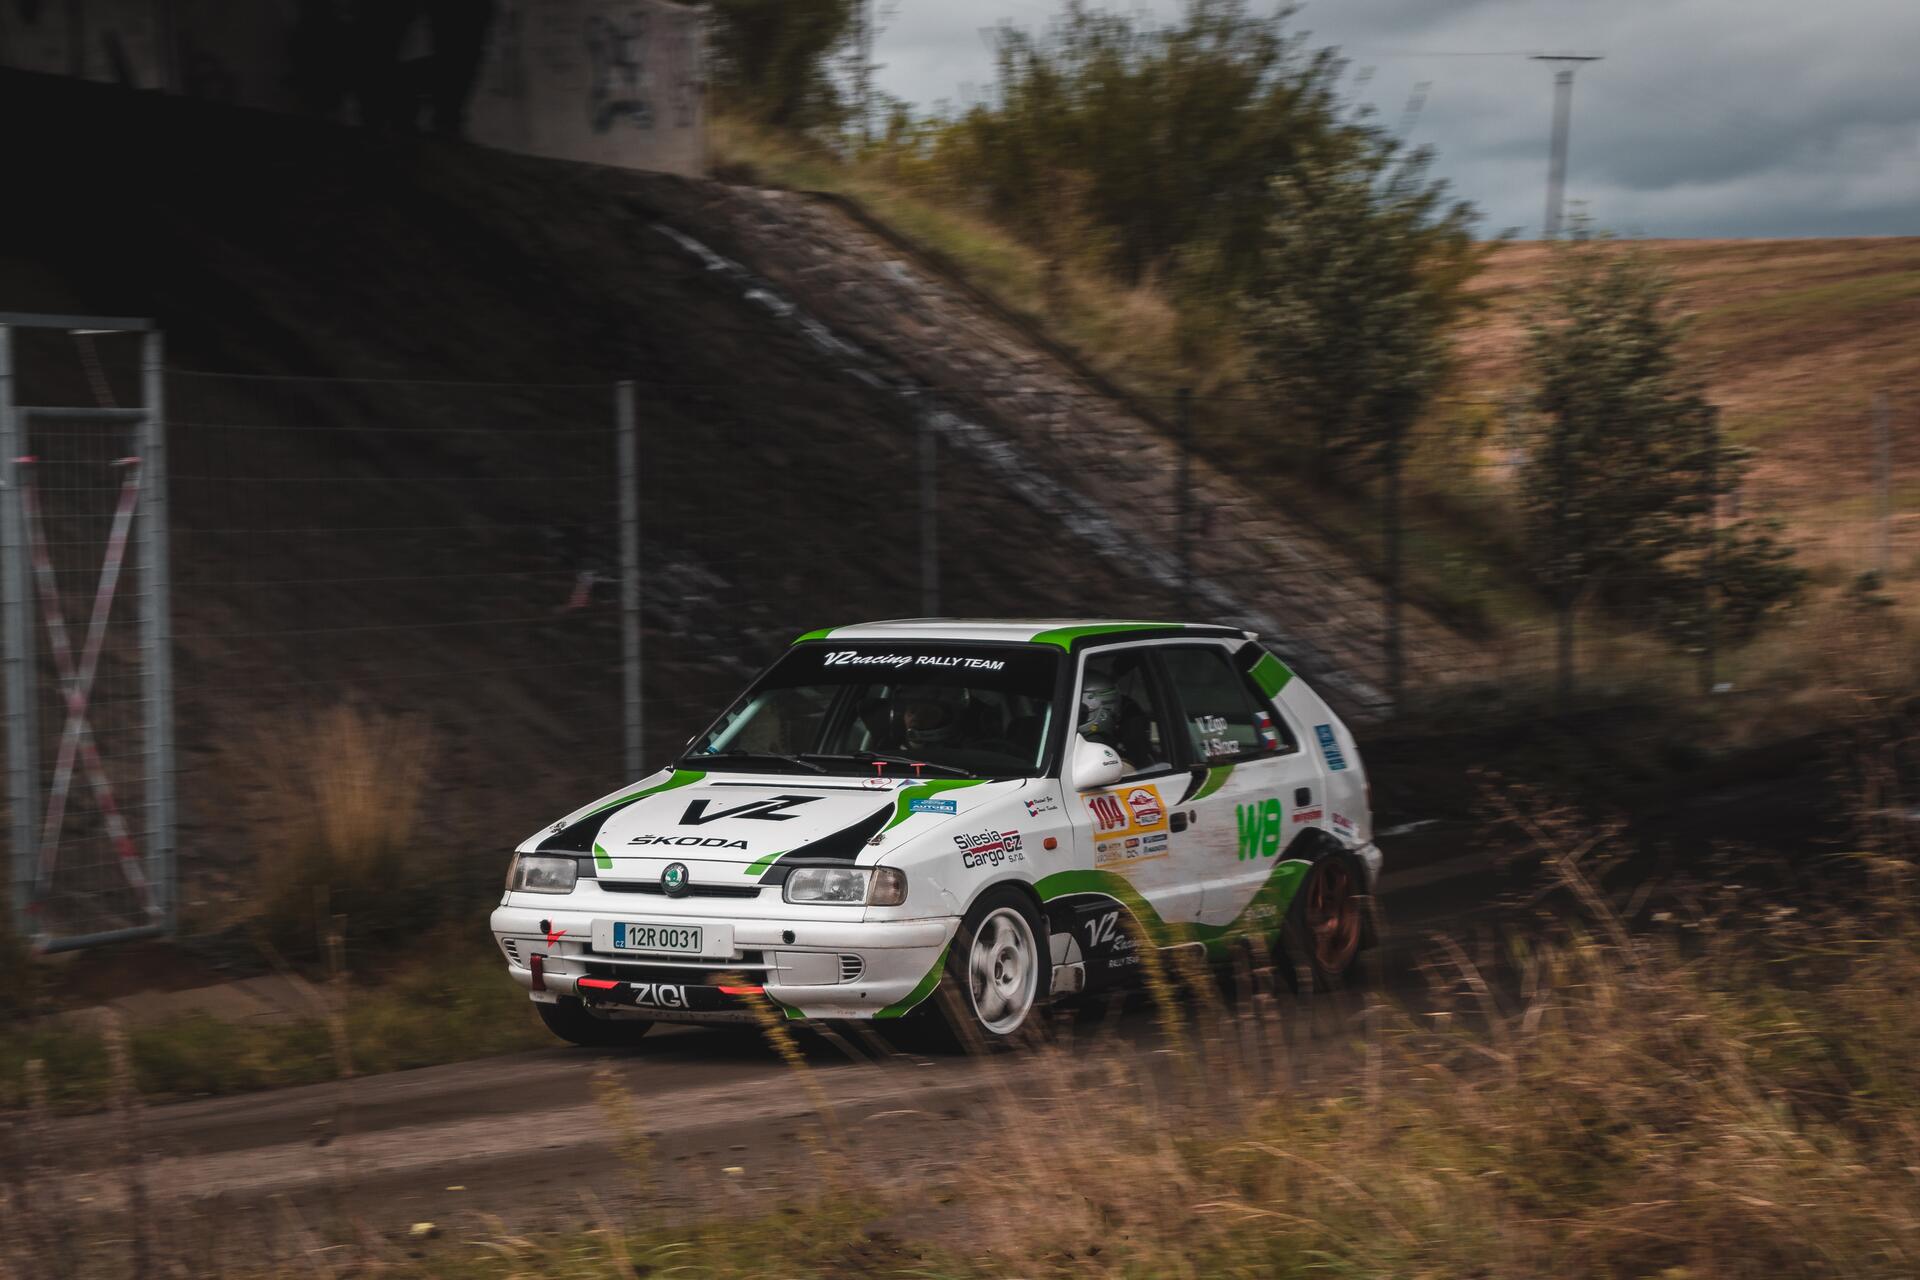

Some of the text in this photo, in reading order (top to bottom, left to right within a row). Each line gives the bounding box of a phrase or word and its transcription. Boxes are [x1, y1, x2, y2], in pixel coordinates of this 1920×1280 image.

[915, 655, 963, 667] RALLY
[964, 658, 1006, 670] TEAM
[1089, 795, 1126, 831] 104
[627, 834, 749, 851] ŠKODA
[953, 828, 1023, 853] Silesia CZ
[962, 849, 1006, 869] Cargo
[615, 940, 625, 948] CZ
[629, 927, 699, 949] 12R 0031
[630, 982, 690, 1009] ZIGI
